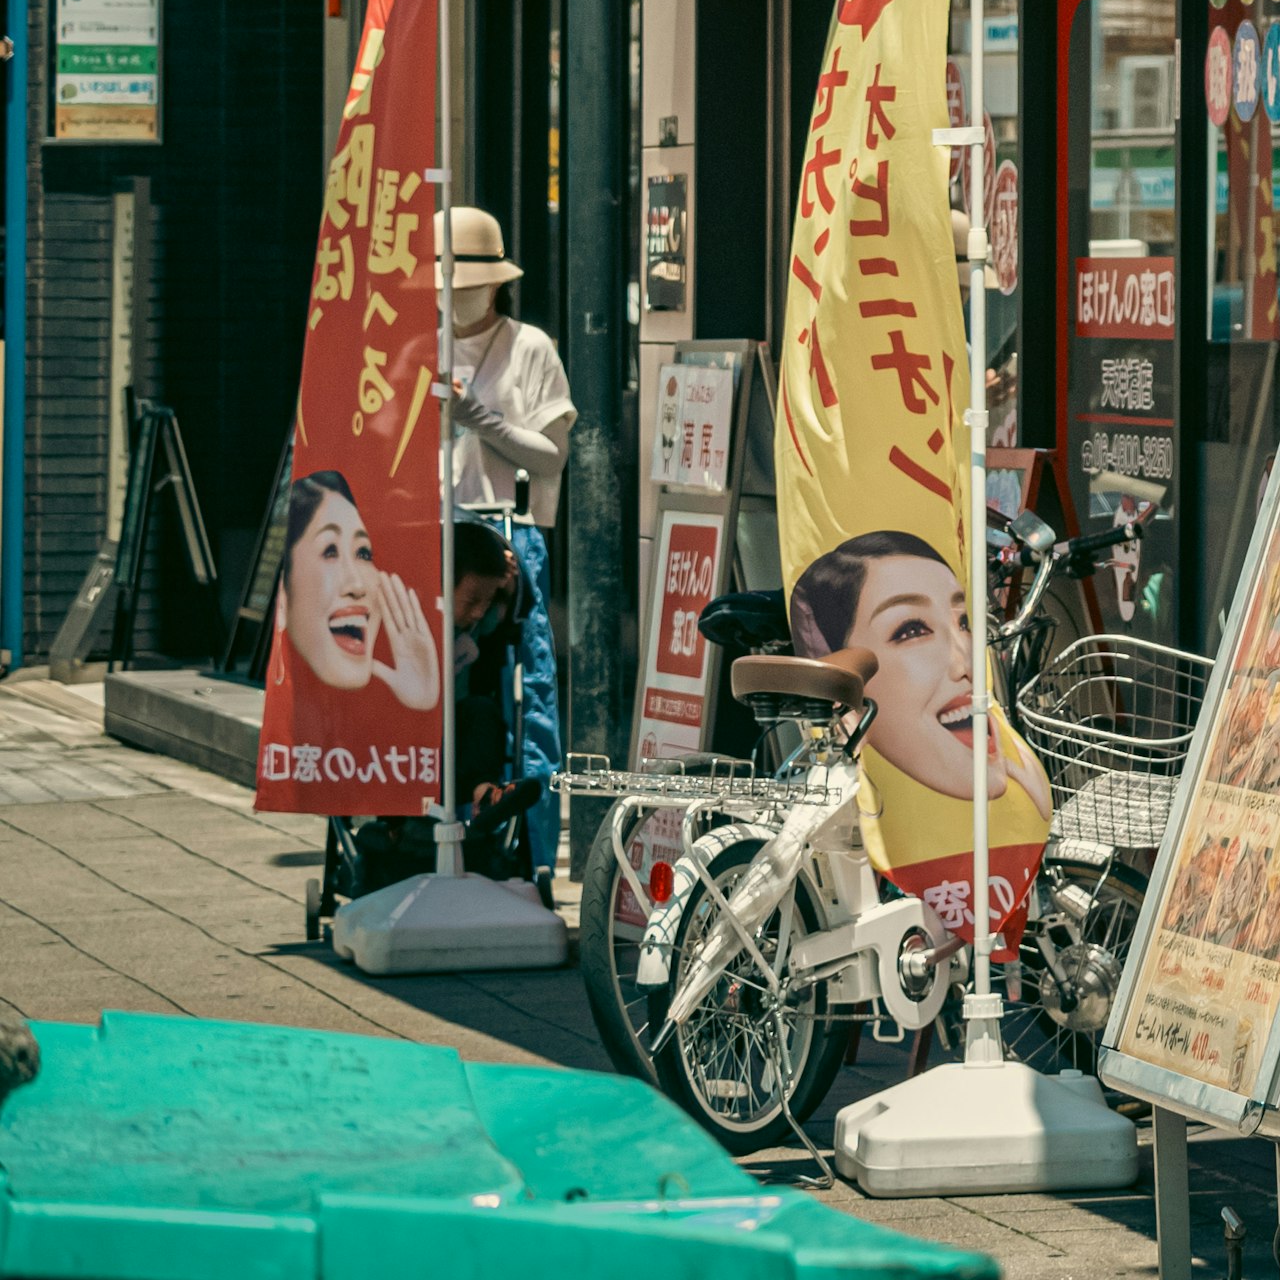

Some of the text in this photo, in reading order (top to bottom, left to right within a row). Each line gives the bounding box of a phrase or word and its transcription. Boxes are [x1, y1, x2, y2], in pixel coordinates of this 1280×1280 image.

[1078, 268, 1174, 327] ほけんの窓口
[666, 550, 713, 599] ほけんの
[670, 608, 697, 657] 窓口
